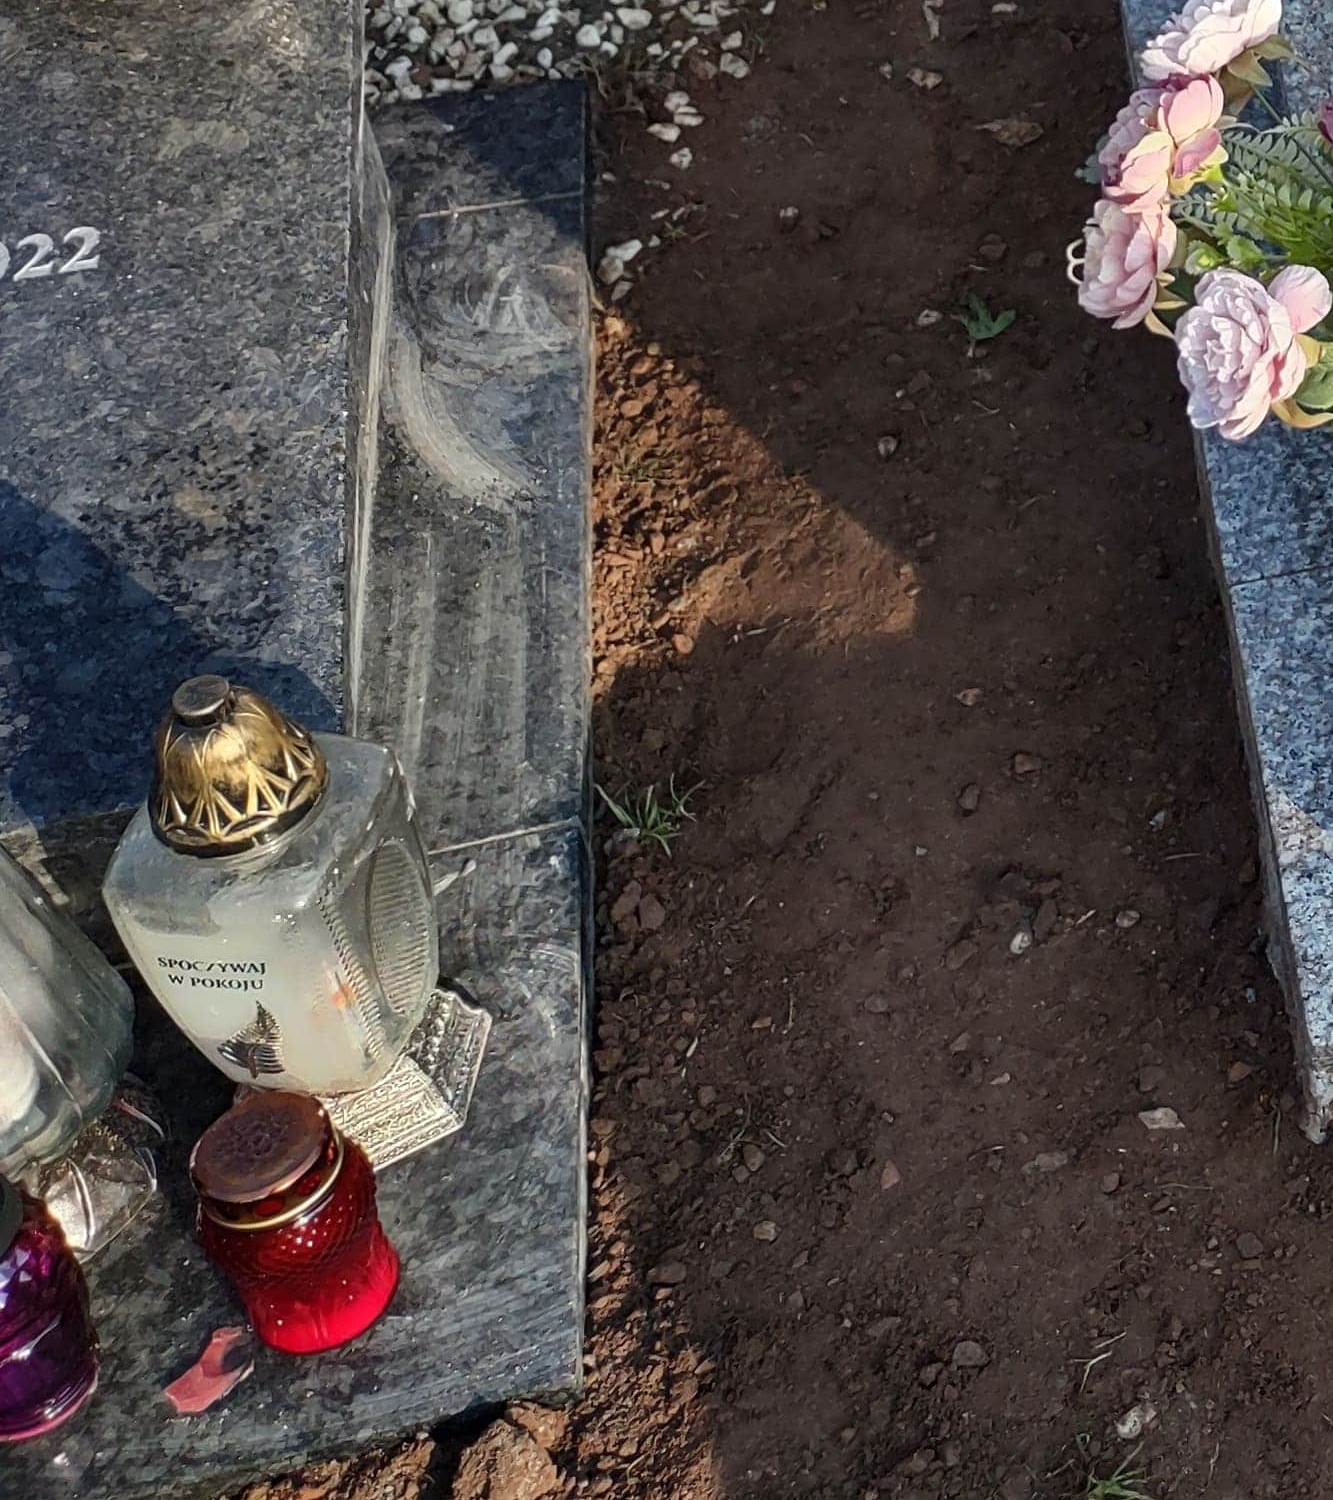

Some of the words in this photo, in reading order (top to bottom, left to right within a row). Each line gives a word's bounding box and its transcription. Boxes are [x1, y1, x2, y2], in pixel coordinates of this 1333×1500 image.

[0, 226, 101, 281] 22
[157, 956, 267, 976] SPOCZYWAJ
[167, 973, 185, 985] W
[190, 976, 264, 992] POKOJU
